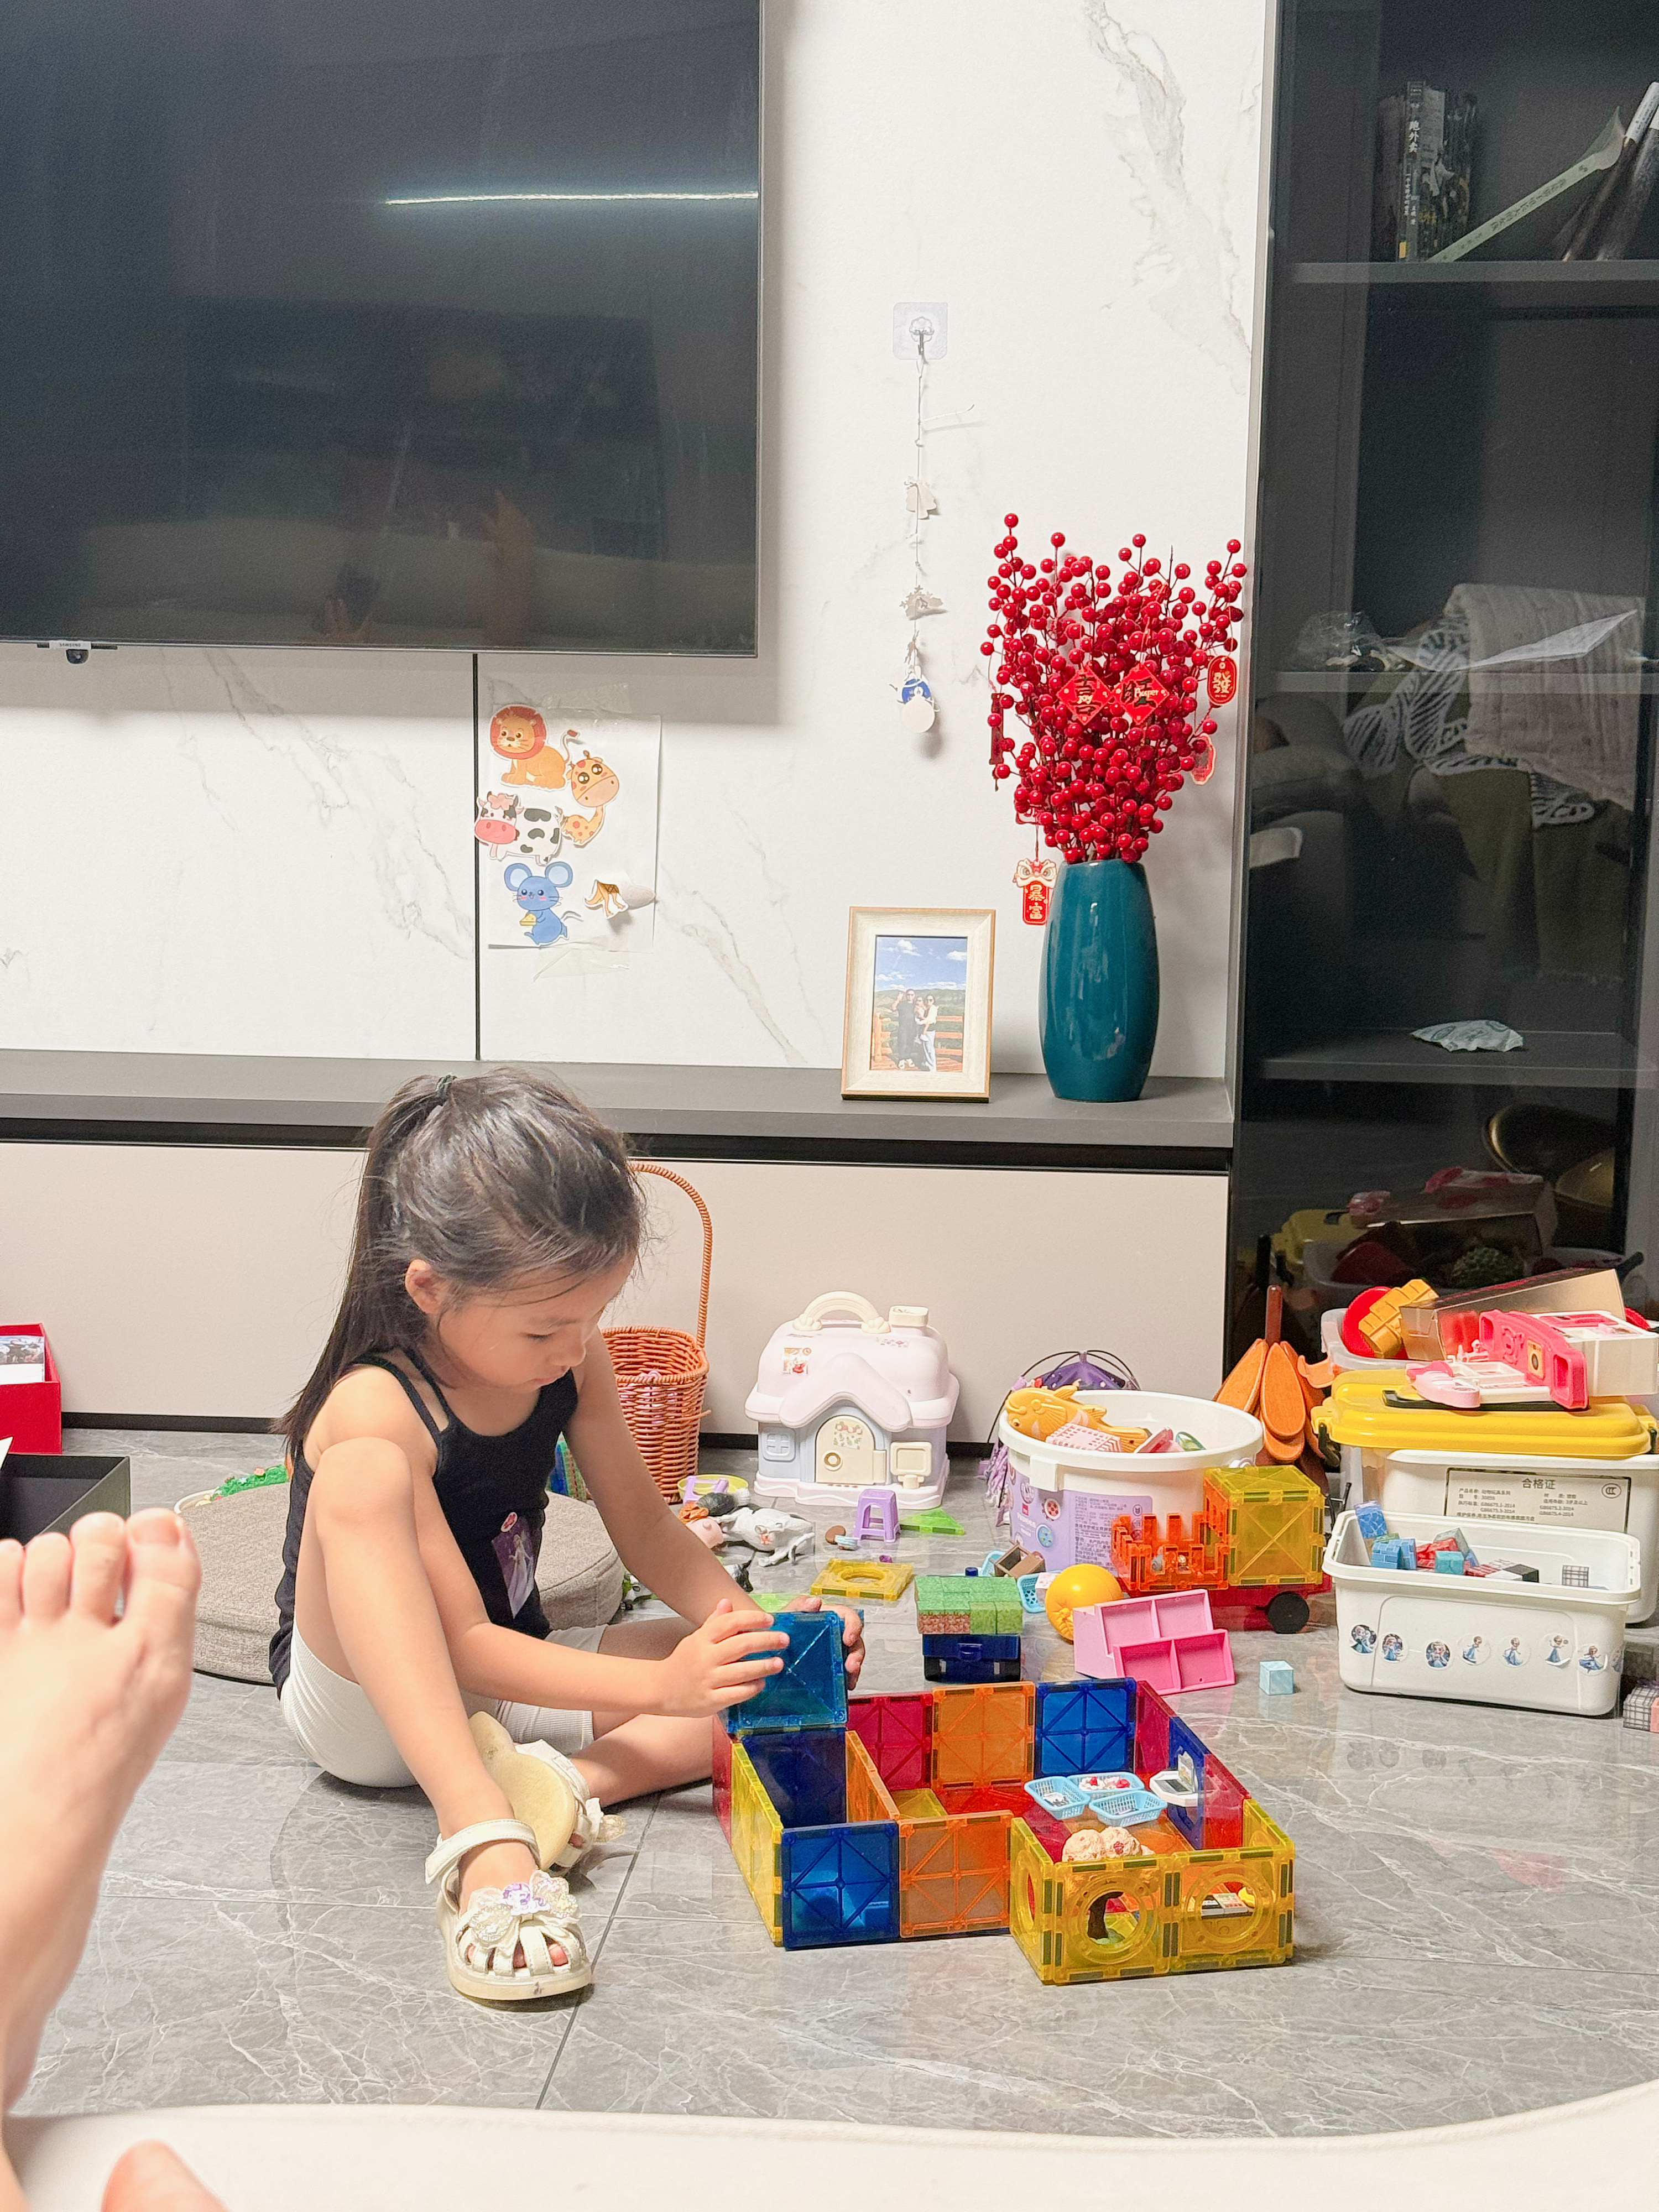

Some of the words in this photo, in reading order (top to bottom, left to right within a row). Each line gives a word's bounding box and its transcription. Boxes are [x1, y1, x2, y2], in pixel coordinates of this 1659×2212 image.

[1027, 884, 1046, 920] 暴富
[1521, 1478, 1556, 1490] 合格证
